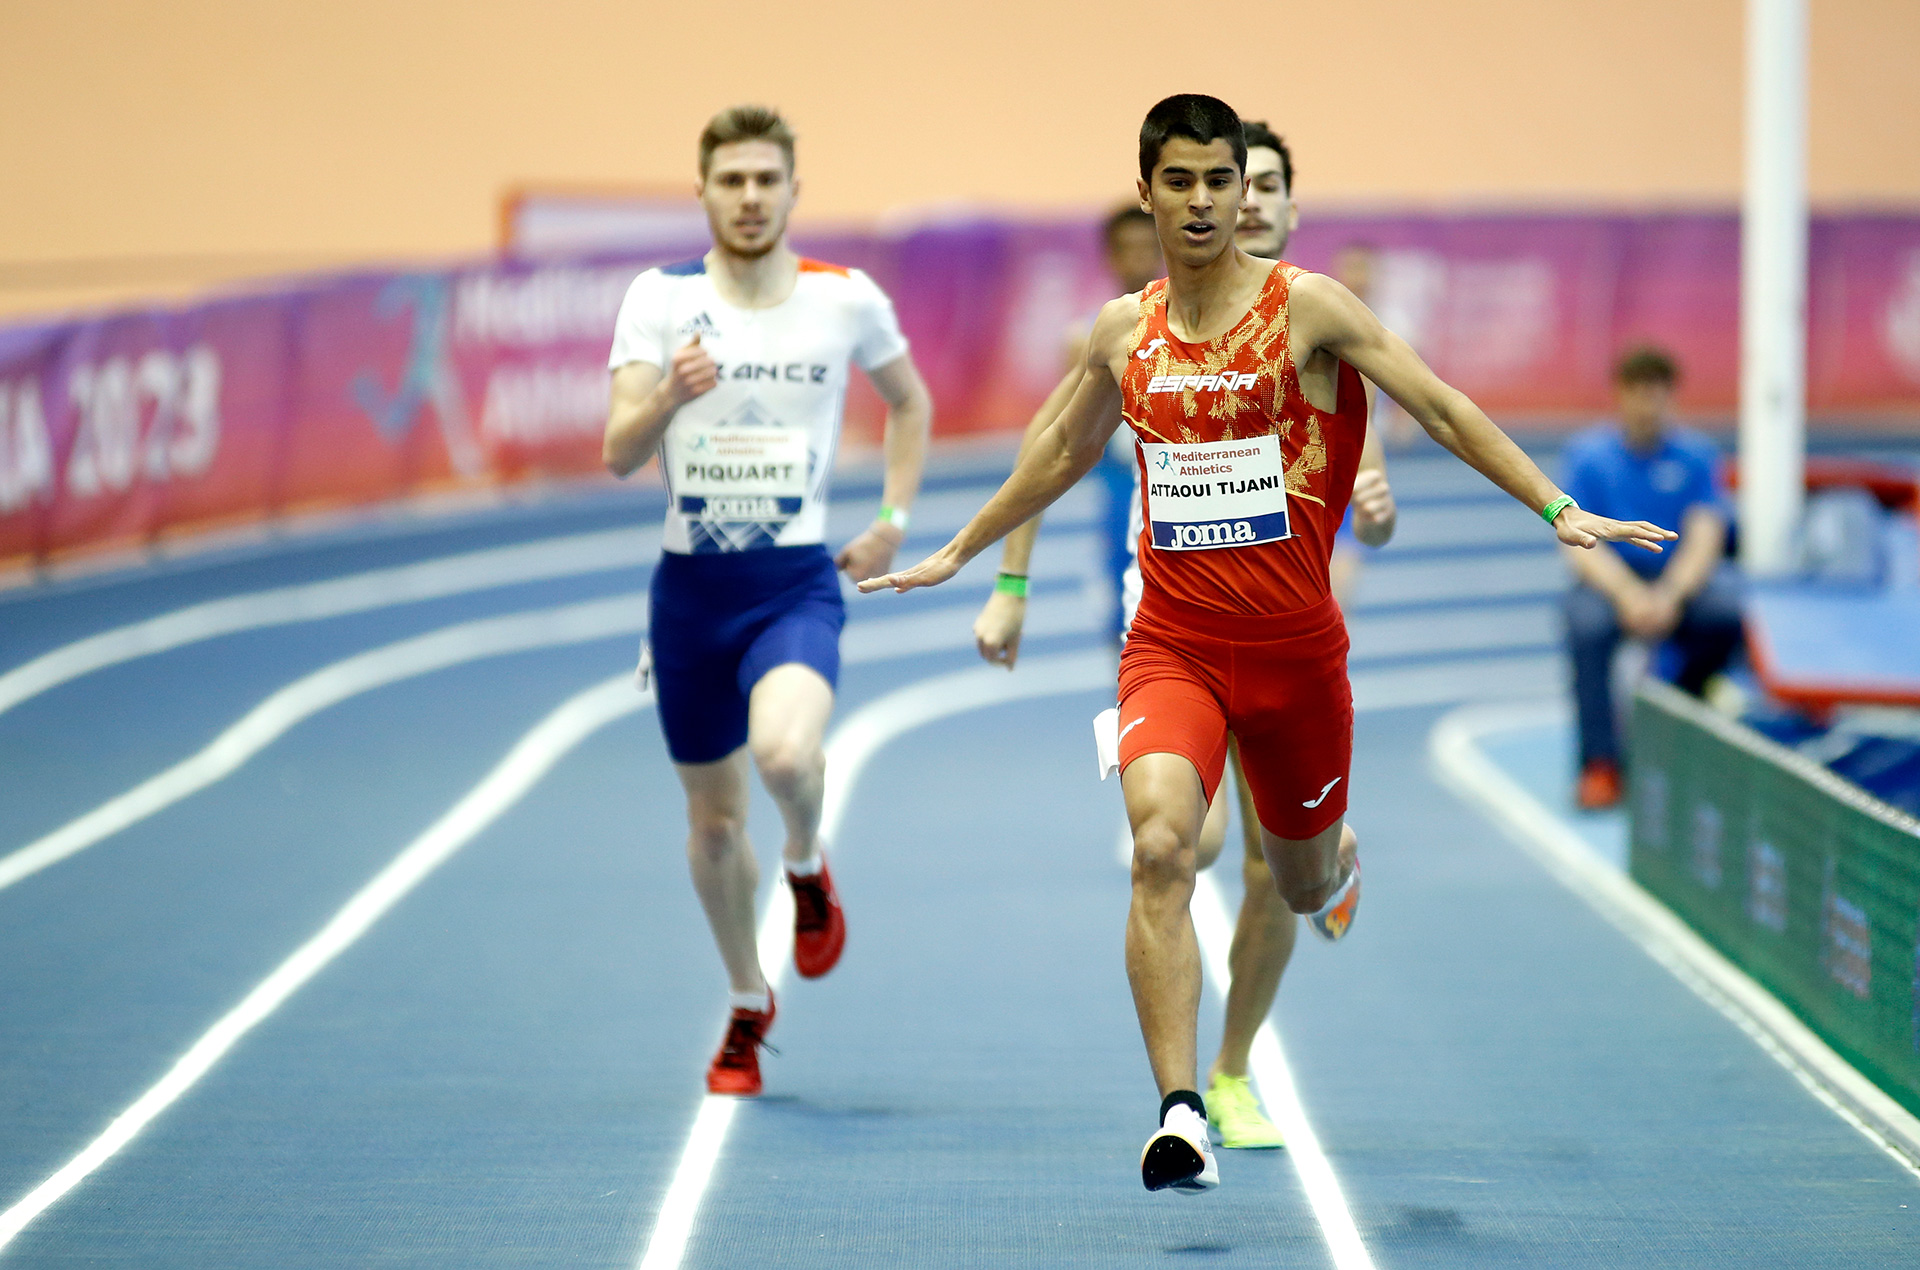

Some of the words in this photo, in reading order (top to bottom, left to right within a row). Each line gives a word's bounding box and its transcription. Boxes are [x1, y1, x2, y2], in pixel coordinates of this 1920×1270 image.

[1146, 370, 1259, 394] ESPAÑA
[67, 344, 222, 498] 2023
[1172, 447, 1261, 462] Mediterranean
[685, 464, 794, 482] PIQUART
[1179, 463, 1233, 476] Athletics
[1150, 483, 1211, 498] ATTAOUI
[1216, 475, 1279, 495] TIJANI
